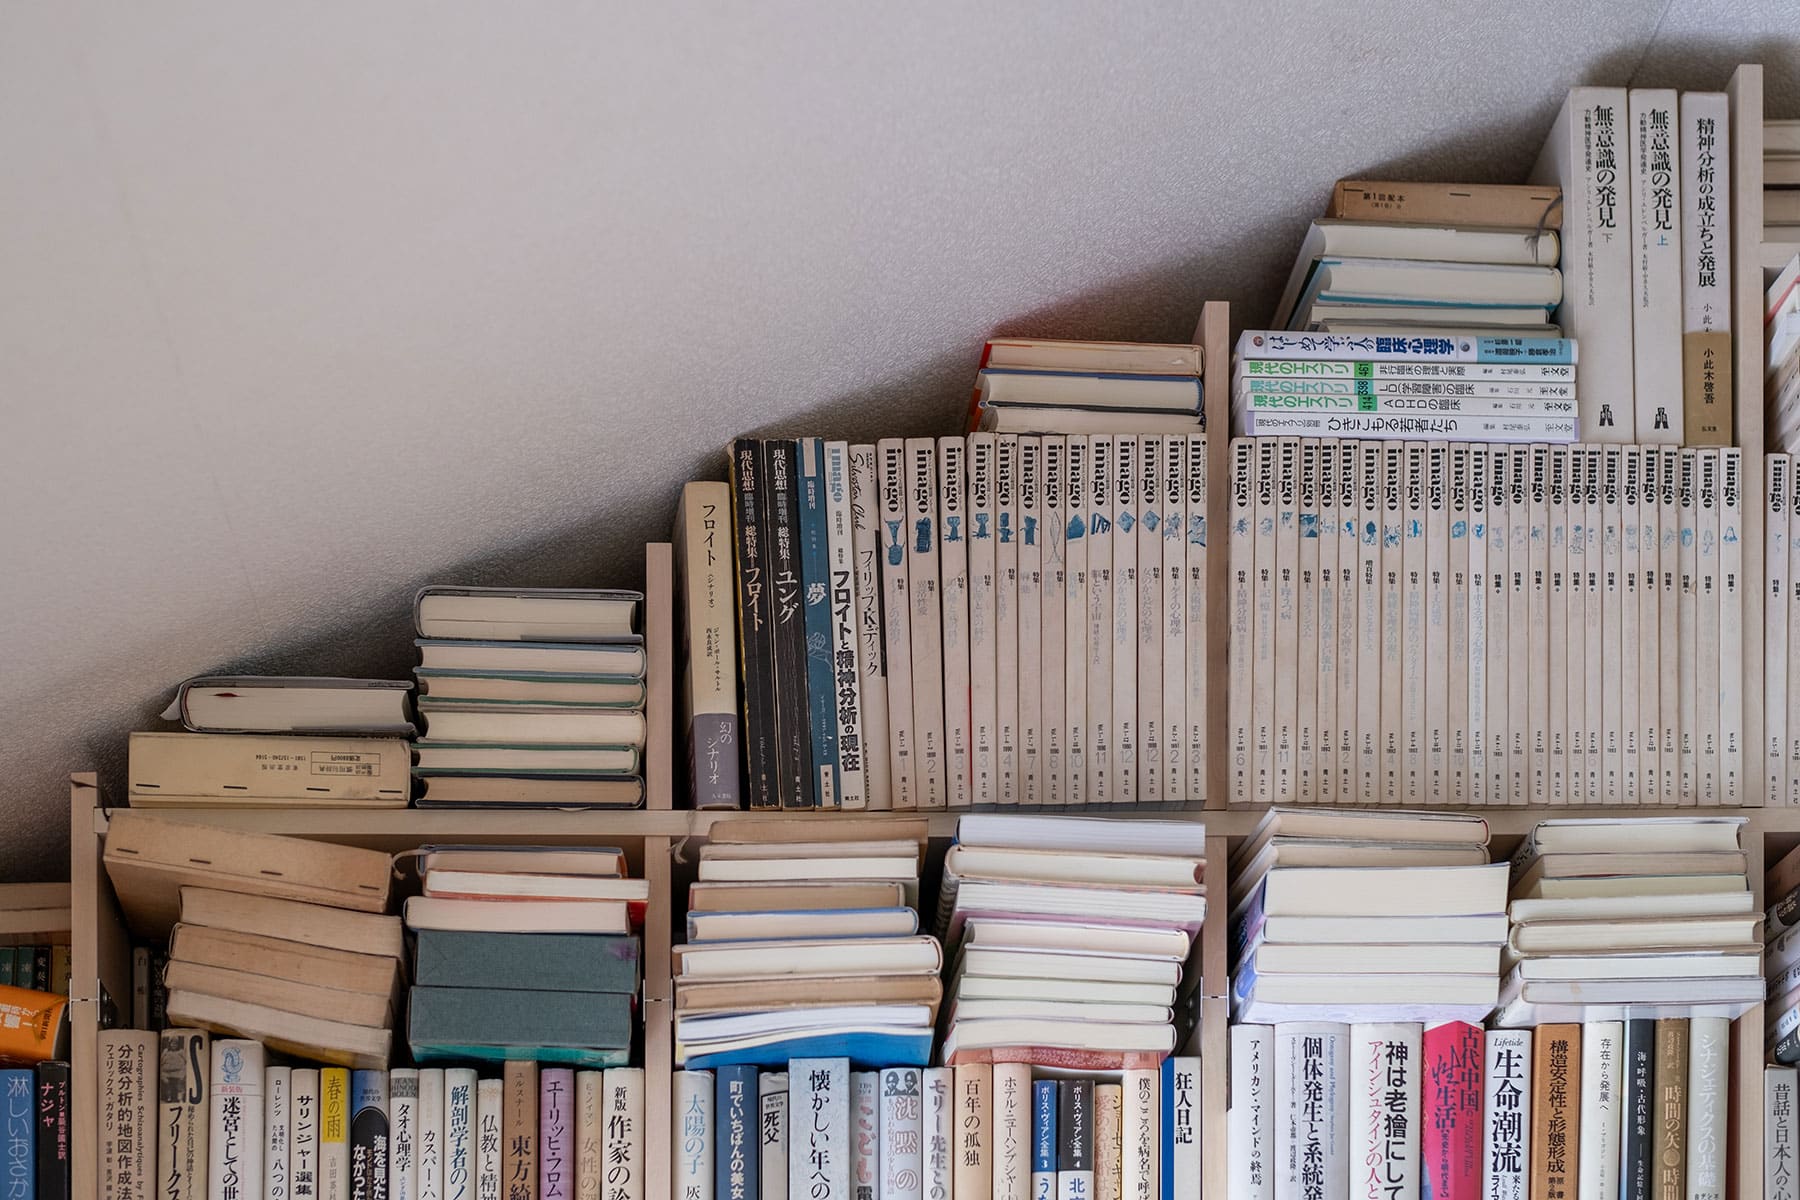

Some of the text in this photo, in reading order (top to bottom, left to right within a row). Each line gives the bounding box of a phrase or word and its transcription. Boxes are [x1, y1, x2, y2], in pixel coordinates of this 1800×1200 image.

[1594, 106, 1616, 243] 無意識の発見 下
[1650, 109, 1672, 246] 無意識の発見 上
[1696, 118, 1717, 288] 精神分析の成立ちと発展
[1249, 361, 1569, 376] 現代のエスプリ 461 非行臨床の理論と実際 至文堂
[1270, 334, 1456, 355] はじめて学ぶ人の臨床心理学
[1703, 348, 1715, 404] 小此木啓吾
[1250, 381, 1348, 394] 現代のエスプリ
[1358, 381, 1369, 395] 398
[1540, 386, 1568, 396] 至文堂
[1254, 395, 1572, 412] 現代のエスプリ 414 ADHDの臨床 至文堂
[1328, 417, 1573, 433] ひきこもる若者たち 至文堂
[740, 450, 754, 492] 現代思想
[772, 449, 787, 490] 現代思想
[884, 448, 902, 512] imago
[944, 447, 962, 511] imago
[972, 443, 992, 508] imago
[1020, 445, 1039, 509] imago
[1043, 444, 1062, 508] imago
[1091, 442, 1110, 506] imago
[1115, 441, 1136, 505] imago
[1165, 441, 1184, 504] imago
[1188, 440, 1206, 504] imago
[1258, 443, 1276, 505] imago
[1279, 442, 1298, 505] imago
[1321, 445, 1337, 507] imago
[1340, 445, 1358, 507] imago
[1384, 449, 1402, 510] imago
[1407, 448, 1425, 510] imago
[1451, 450, 1469, 511] imago
[1470, 451, 1488, 512] imago
[1511, 450, 1527, 504] imago
[1531, 449, 1547, 502] imago
[1570, 450, 1585, 504] imago
[1586, 450, 1601, 504] imago
[1624, 452, 1640, 505] imago
[1643, 450, 1659, 503] imago
[1679, 454, 1695, 507] imago
[1701, 455, 1716, 508] imago
[1769, 460, 1786, 512] imago
[702, 504, 716, 566] フロイト
[744, 492, 755, 522] 臨時増刊
[776, 493, 788, 523] 臨時増刊
[852, 504, 866, 534] Club
[746, 567, 763, 632] フロイト
[776, 571, 799, 624] ユング
[860, 551, 878, 677] フィリップ・K・ディック
[1169, 585, 1182, 638] ゲイの心理学
[806, 480, 831, 798] 臨時増刊 夢 青土社
[833, 572, 861, 772] フロイトと精神分析の現在
[706, 738, 720, 784] シナリオ
[720, 722, 732, 744] 幻の
[1096, 752, 1106, 764] 11
[1120, 750, 1133, 764] 12
[1146, 750, 1158, 762] 12
[1170, 750, 1179, 764] 2
[1236, 754, 1245, 766] 6
[1278, 751, 1289, 763] 11
[1342, 752, 1349, 763] 2
[928, 760, 936, 772] 2
[188, 1035, 203, 1105] S
[1494, 1038, 1524, 1048] Lifetide
[1599, 1038, 1612, 1112] 存在から発展へ
[40, 1082, 54, 1128] ナジャ
[105, 1045, 114, 1132] フェリックス・ガタリ
[136, 1044, 145, 1191] Cartographies Schizoanalytiques by
[327, 1076, 342, 1138] 春の雨
[1176, 1072, 1192, 1144] 狂人日記
[1249, 1040, 1262, 1186] アメリカン・マインドの終焉
[1302, 1036, 1324, 1200] 個体発生と系統発
[1366, 1040, 1384, 1199] アインシュタインの人と
[1492, 1050, 1523, 1173] 生命潮流
[1546, 1040, 1568, 1173] 構造安定性と形態形成
[1636, 1051, 1647, 1136] 海・呼吸・古代形象
[1698, 1034, 1717, 1188] シナジェティクスの基礎
[8, 1077, 30, 1200] 淋しいおさか
[118, 1045, 134, 1200] 分裂分析的地図作成法
[166, 1106, 182, 1200] フリークス
[222, 1097, 241, 1200] 迷宮としての世
[272, 1080, 284, 1200] ローレンツ 八つの
[295, 1094, 314, 1196] サリンジャー選集
[395, 1104, 412, 1172] タオ心理学
[450, 1084, 468, 1200] 解剖学者のノ
[509, 1072, 532, 1200] ユルスナール 東方綺
[546, 1081, 564, 1198] エーリッヒ・フロム
[608, 1086, 632, 1200] 新版 作家の診
[684, 1094, 705, 1200] 太陽の子 灰
[729, 1080, 745, 1199] 町でいちばんの美女
[764, 1110, 780, 1146] 死父
[808, 1070, 831, 1200] 懐かしい年への
[895, 1096, 918, 1190] 沈黙の
[929, 1080, 948, 1200] モリー先生との
[964, 1080, 981, 1167] 百年の孤独
[1004, 1077, 1018, 1192] ホテル・ニューハンプシャー
[1040, 1086, 1050, 1158] ボリス・ヴィアン全集
[1073, 1086, 1083, 1158] ボリス・ヴィアン全集
[1384, 1042, 1408, 1200] 神は老獪にして
[1662, 1086, 1682, 1200] 時間の矢 時間
[1772, 1084, 1791, 1200] 昔話と日本人の心
[352, 1144, 366, 1200] なかった
[373, 1136, 388, 1200] 海を見た
[422, 1130, 437, 1200] カスパー・ハ
[1041, 1160, 1048, 1168] 3
[1074, 1160, 1081, 1168] 4
